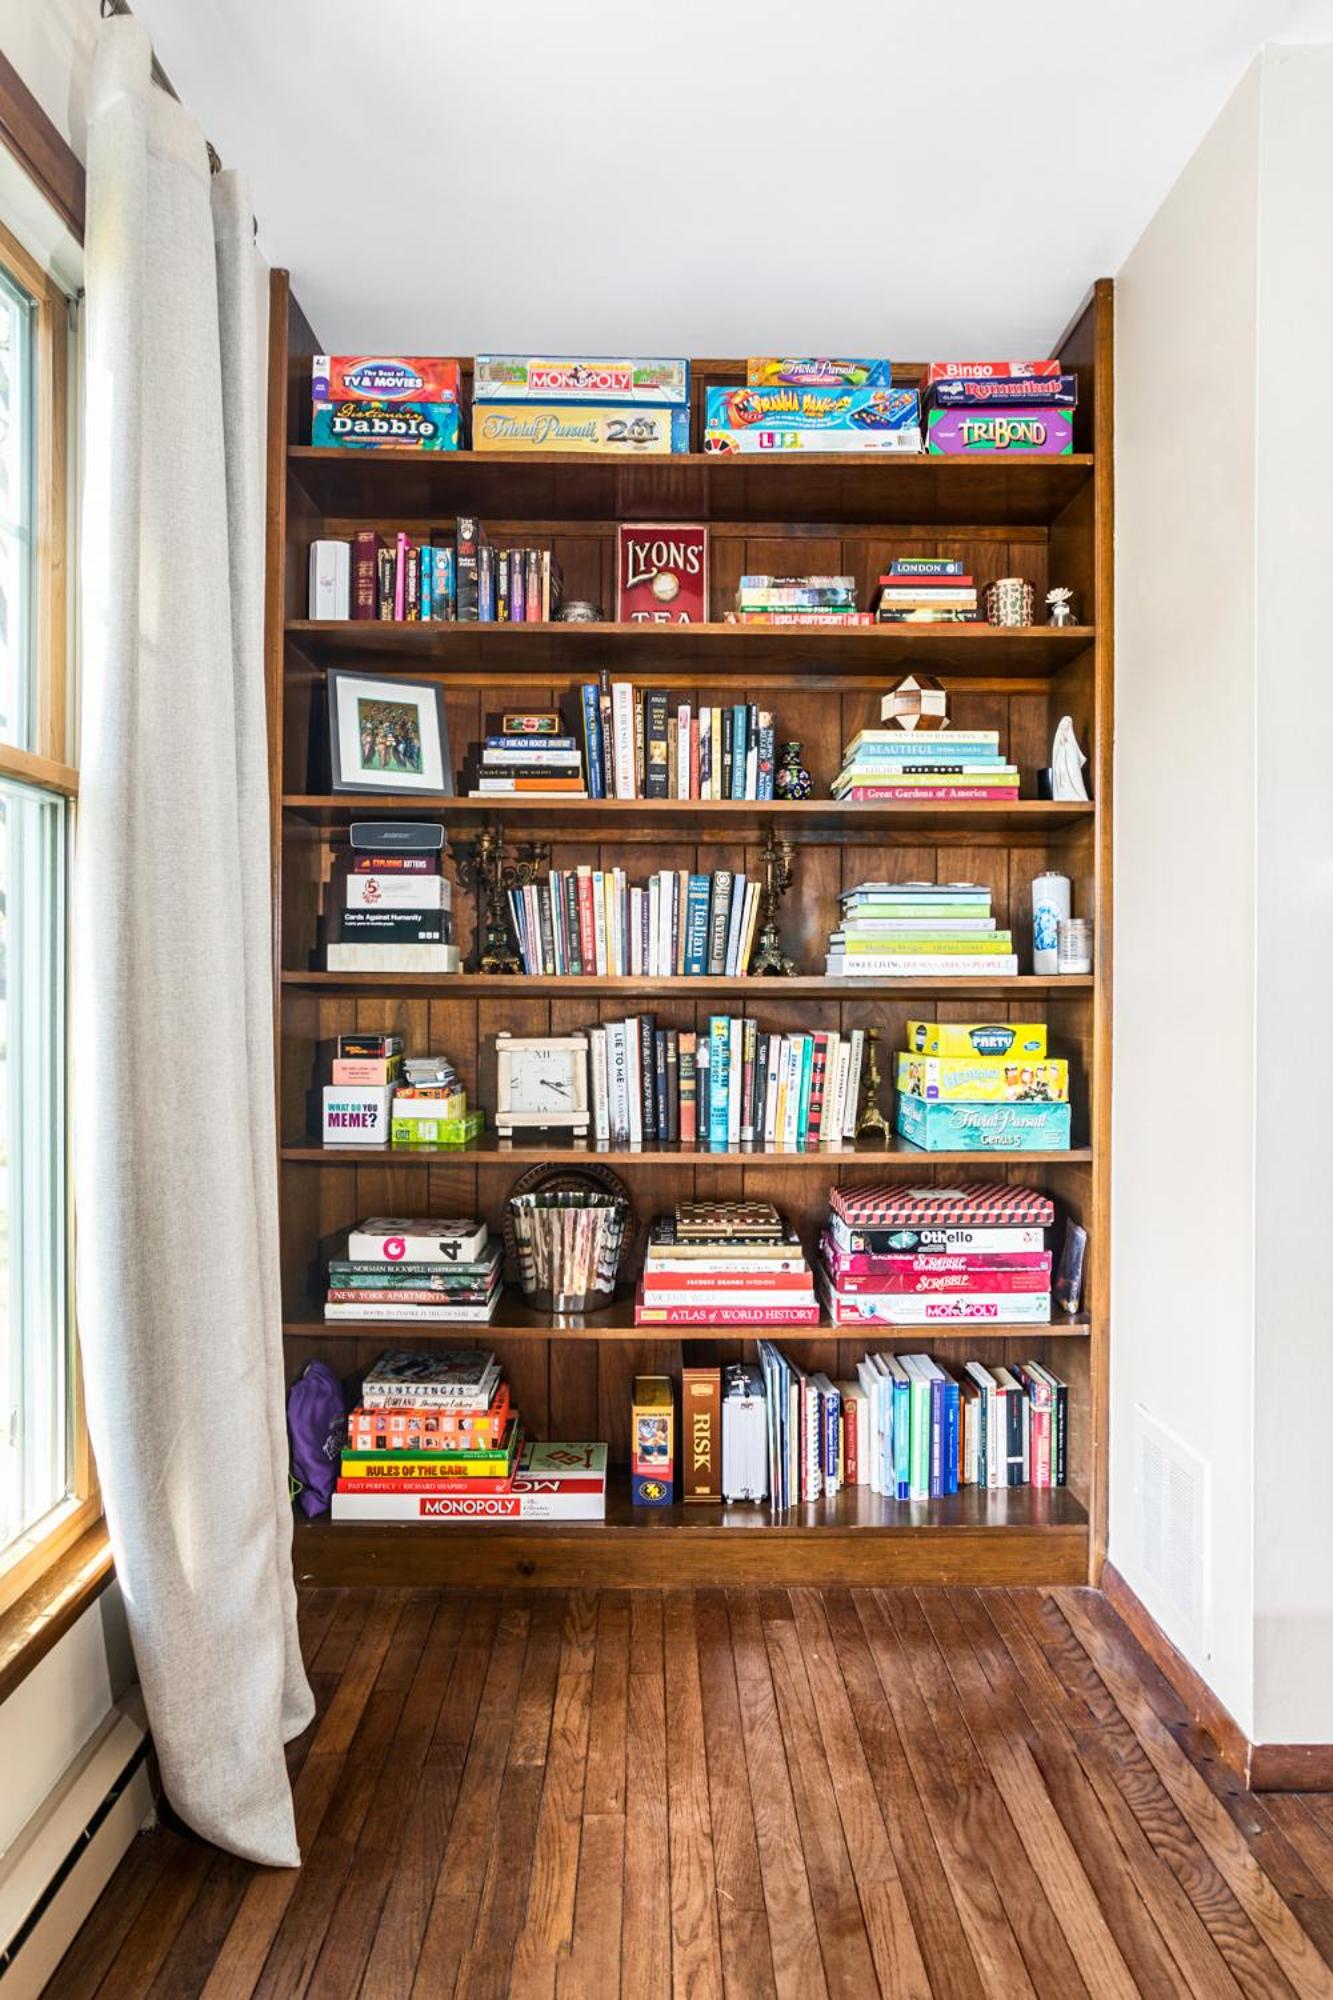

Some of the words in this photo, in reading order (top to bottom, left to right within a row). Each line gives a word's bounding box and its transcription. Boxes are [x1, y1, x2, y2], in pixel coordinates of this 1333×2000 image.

[783, 360, 818, 375] Trivial
[817, 360, 857, 377] Pursuit
[946, 364, 993, 378] Bingo
[373, 378, 423, 388] MOVIES
[531, 372, 629, 388] MONOPOLY
[965, 380, 1063, 399] Rummikub
[332, 417, 434, 435] Dabble
[483, 414, 537, 438] Trivial
[532, 414, 599, 443] Pursuit
[897, 564, 941, 572] LONDON
[869, 744, 935, 754] BEAUTIFUL
[867, 788, 893, 799] Great
[895, 788, 934, 799] Gardens
[936, 788, 946, 798] of
[946, 788, 988, 799] America
[367, 880, 377, 894] 5
[344, 913, 365, 921] Cards
[365, 913, 390, 922] Against
[391, 913, 422, 923] Humanity
[693, 903, 708, 957] Italian
[614, 1033, 623, 1048] LIE
[972, 1035, 1014, 1048] PARTY
[615, 1052, 624, 1066] TO
[616, 1069, 625, 1083] ME
[328, 1103, 349, 1112] WHAT
[351, 1103, 361, 1112] DO
[363, 1103, 378, 1112] YOU
[328, 1112, 378, 1128] MEME?
[952, 1108, 999, 1129] Trivial
[996, 1107, 1048, 1134] Pursuit
[920, 1231, 973, 1244] Othello
[439, 1240, 462, 1261] 4
[913, 1253, 968, 1269] SCRABBLE
[353, 1265, 386, 1273] NORMAN
[387, 1265, 425, 1273] ROCKWELL
[916, 1275, 970, 1291] SCRABBLE
[334, 1291, 356, 1300] NEW
[360, 1291, 383, 1300] YORK
[388, 1291, 445, 1301] APARTMENTS
[671, 1311, 706, 1321] ATLAS
[708, 1310, 717, 1322] of
[720, 1310, 763, 1320] WORLD
[765, 1309, 814, 1320] HISTORY
[927, 1304, 998, 1318] MONOPOLY
[693, 1413, 711, 1472] RISK
[366, 1465, 400, 1476] RULES
[402, 1465, 416, 1476] OF
[417, 1465, 437, 1476] THE
[439, 1465, 468, 1476] GAME
[425, 1500, 515, 1513] MONOPOLY
